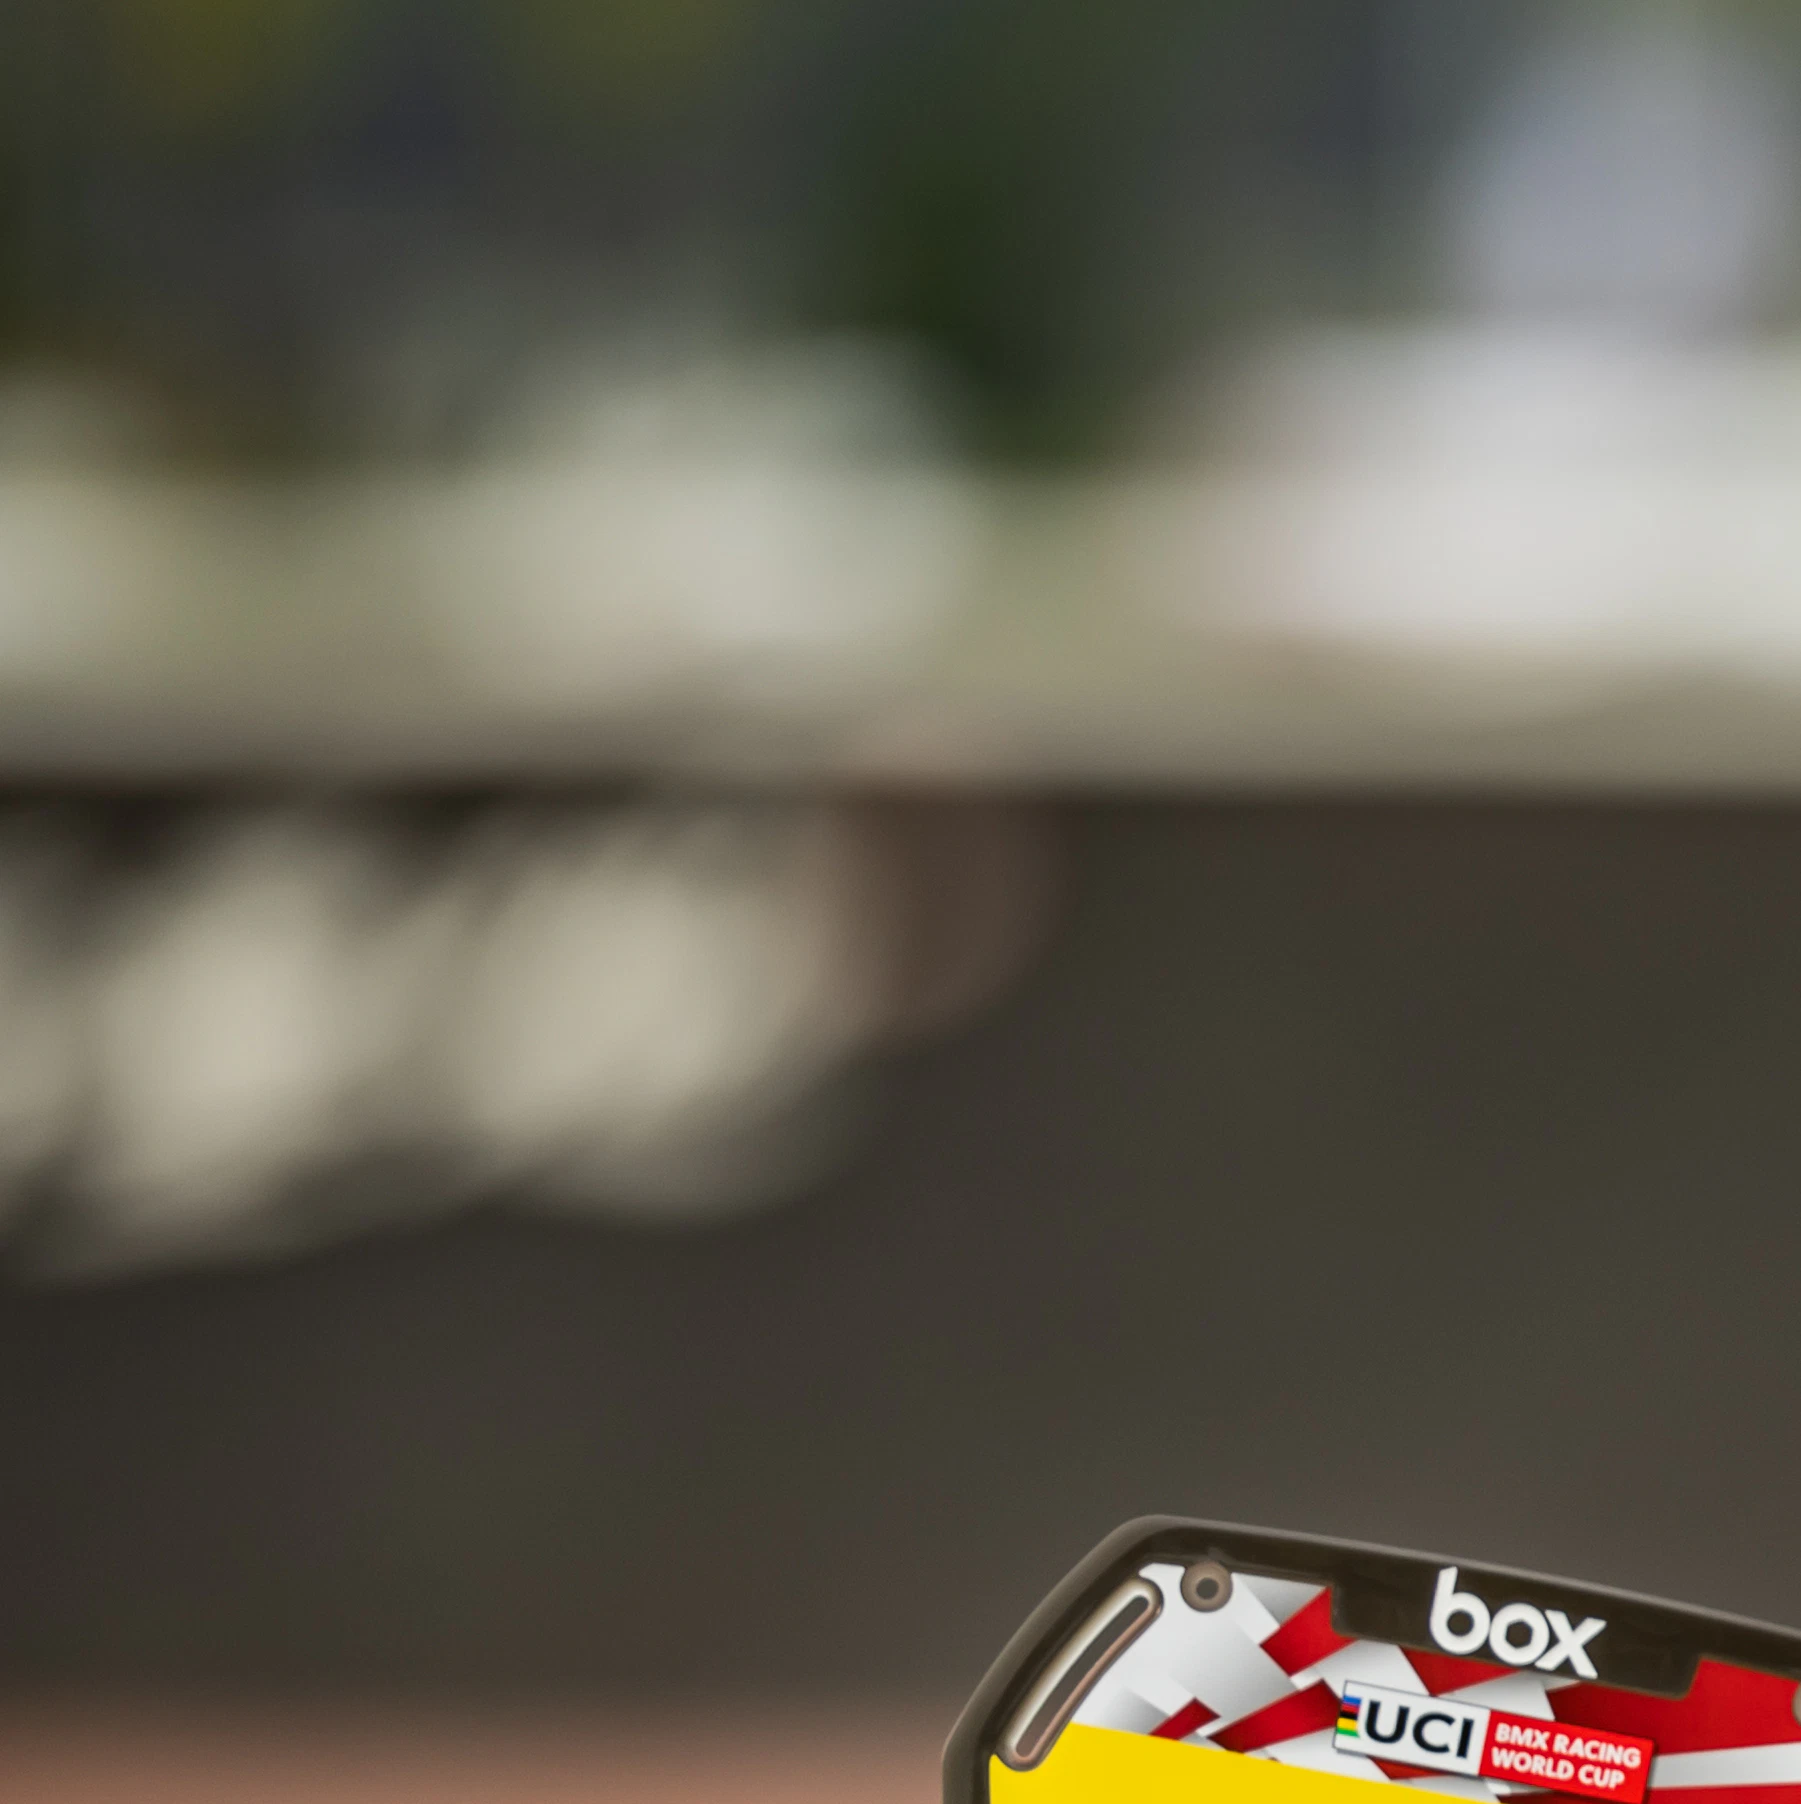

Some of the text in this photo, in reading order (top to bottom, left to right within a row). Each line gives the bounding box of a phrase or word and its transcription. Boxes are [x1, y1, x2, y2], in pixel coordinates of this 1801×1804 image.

[1429, 1566, 1607, 1679] box
[1365, 1700, 1474, 1759] UCI
[1495, 1723, 1641, 1768] BMX RACING
[1491, 1746, 1625, 1790] WORLD CUP
